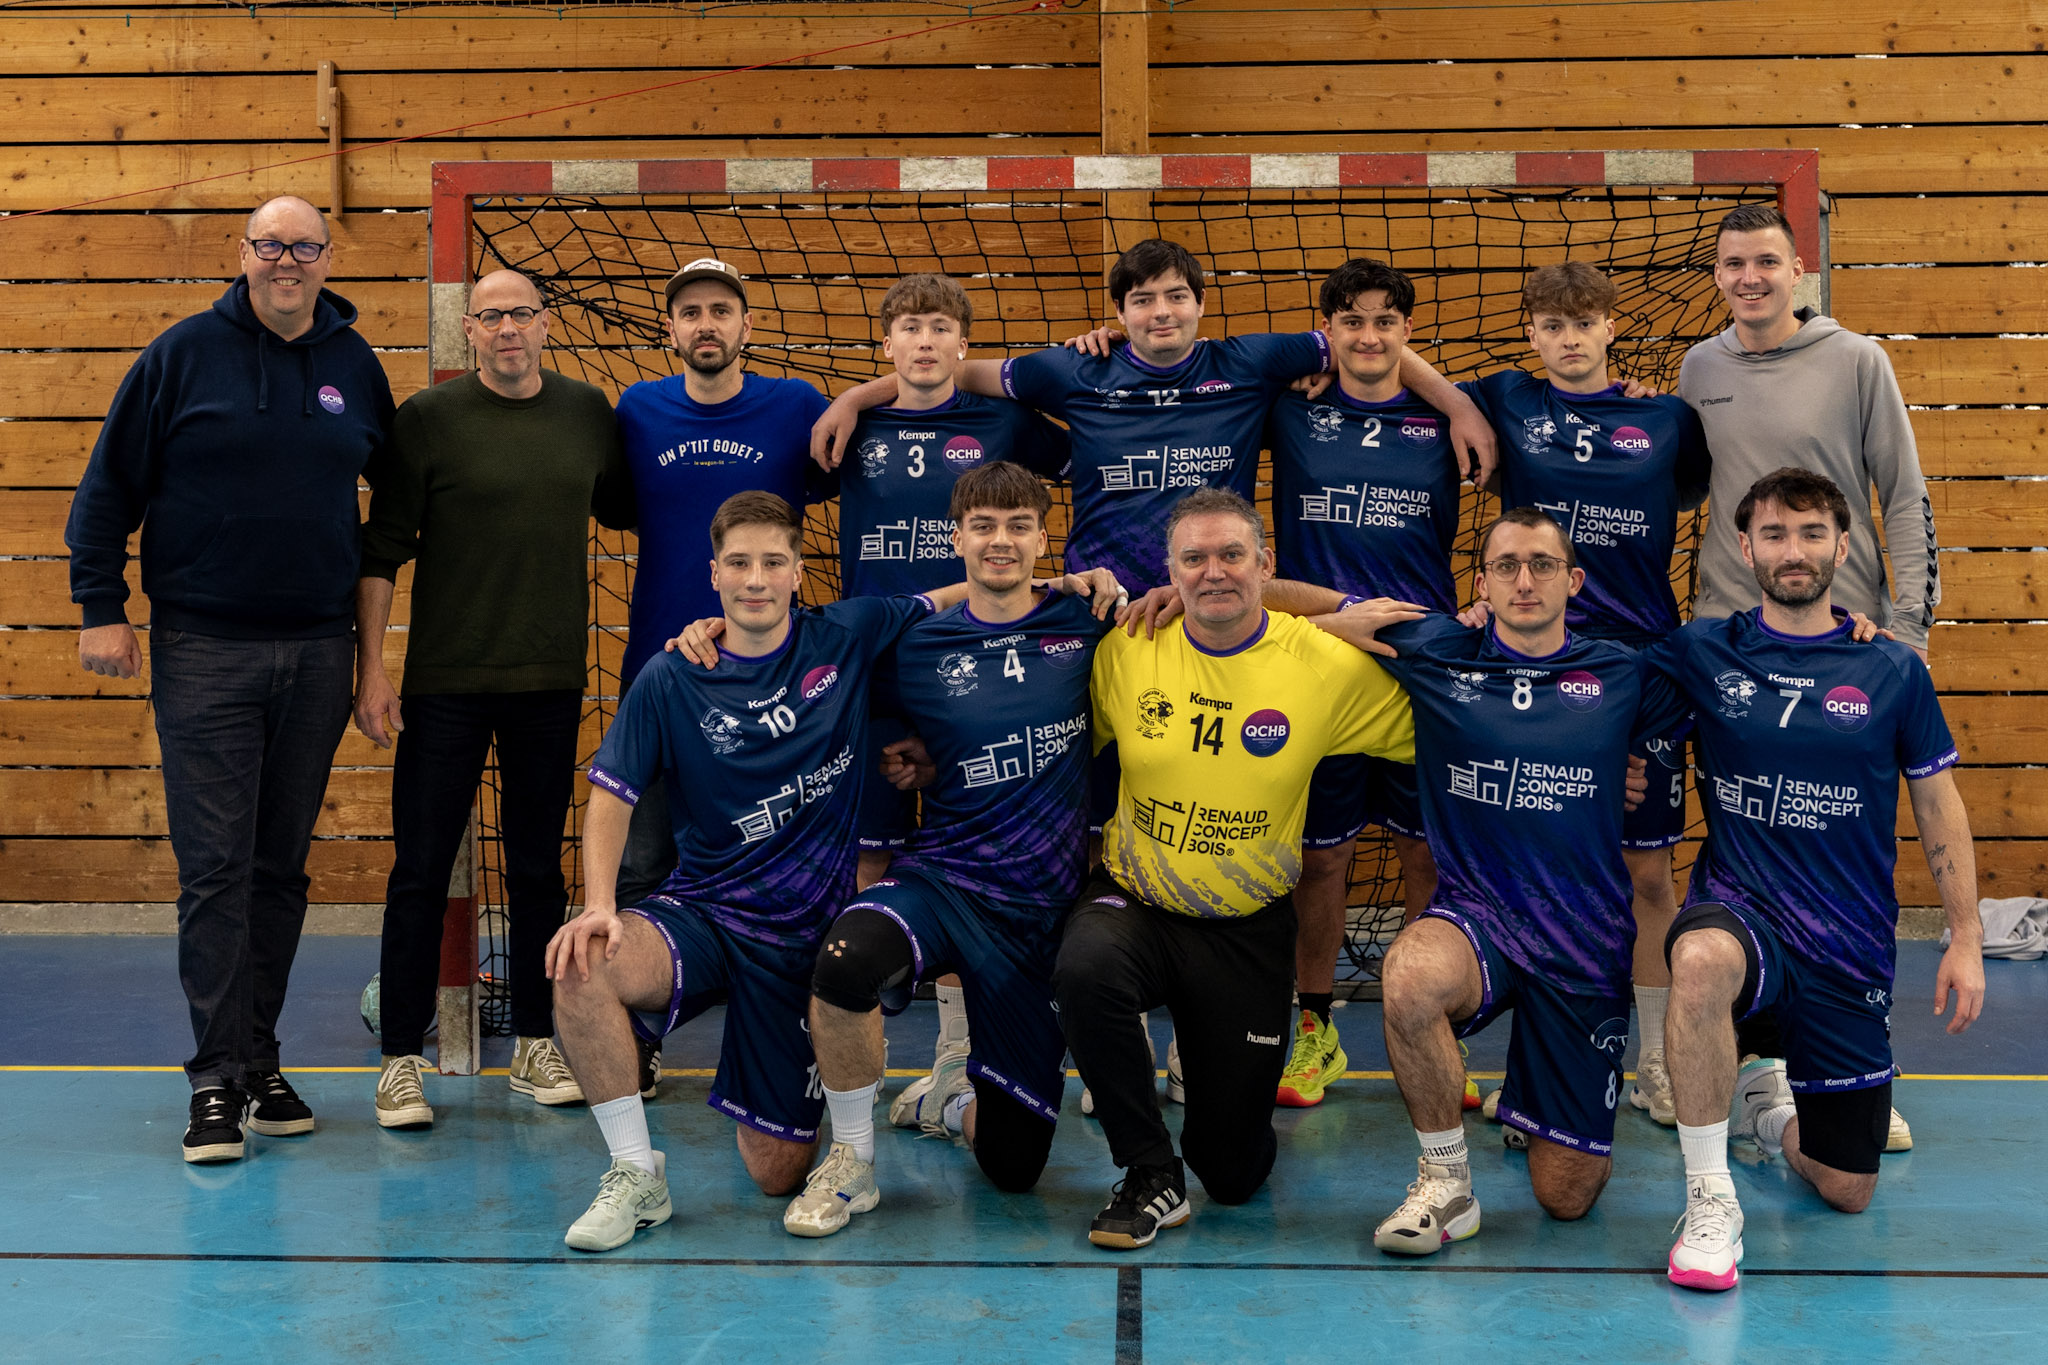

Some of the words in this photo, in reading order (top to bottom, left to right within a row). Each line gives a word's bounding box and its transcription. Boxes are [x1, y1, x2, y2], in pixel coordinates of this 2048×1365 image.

[1148, 389, 1181, 406] 12
[1196, 383, 1232, 394] QCHB
[320, 394, 343, 404] QCHB
[899, 430, 936, 442] Kempa
[1361, 417, 1382, 448] 2
[1401, 425, 1437, 438] QCHB
[658, 448, 676, 466] UN
[713, 439, 754, 459] GODET
[1171, 446, 1231, 460] RENAUD
[1574, 429, 1593, 462] 5
[1613, 439, 1650, 449] QCHB
[907, 444, 926, 478] 3
[945, 449, 981, 460] QCHB
[1169, 458, 1235, 474] CONCEPT
[1369, 486, 1431, 504] RENAUD
[1366, 500, 1431, 518] CONCEPT
[1581, 504, 1645, 522] RENAUD
[919, 520, 957, 532] RENA
[1577, 518, 1650, 537] CONCEPT
[982, 633, 1026, 649] Kempa
[1044, 639, 1083, 655] QCHB
[1003, 648, 1025, 683] 4
[805, 671, 838, 699] QCHB
[1560, 681, 1601, 696] QCHB
[1768, 673, 1815, 688] Kempa
[748, 686, 787, 709] Kempa
[1189, 692, 1232, 711] Kempa
[1512, 677, 1533, 710] 8
[1779, 688, 1802, 728] 7
[1826, 700, 1868, 716] QCHB
[757, 704, 796, 739] 10
[1190, 713, 1223, 756] 14
[1245, 725, 1287, 737] QCHB
[594, 770, 621, 790] Kempa
[1521, 762, 1593, 782] RENAUD
[1518, 778, 1598, 798] CONCEPT
[1669, 773, 1682, 808] 5
[1785, 779, 1858, 800] RENAUD
[1198, 807, 1268, 824] RENAUD
[1781, 796, 1863, 817] CONCEPT
[1192, 824, 1271, 840] CONCEPT
[1315, 836, 1342, 845] Kempa
[1636, 839, 1662, 848] Kempa
[656, 921, 676, 950] Kempa
[1246, 1031, 1281, 1046] hummel
[981, 1064, 1008, 1086] Kempa
[1013, 1085, 1040, 1108] Kempa
[1605, 1069, 1616, 1110] 8
[1824, 1077, 1857, 1087] Kempa
[721, 1098, 748, 1117] Kempa
[755, 1116, 785, 1133] Kempa
[1510, 1110, 1540, 1130] Kempa
[1548, 1129, 1579, 1146] Kempa
